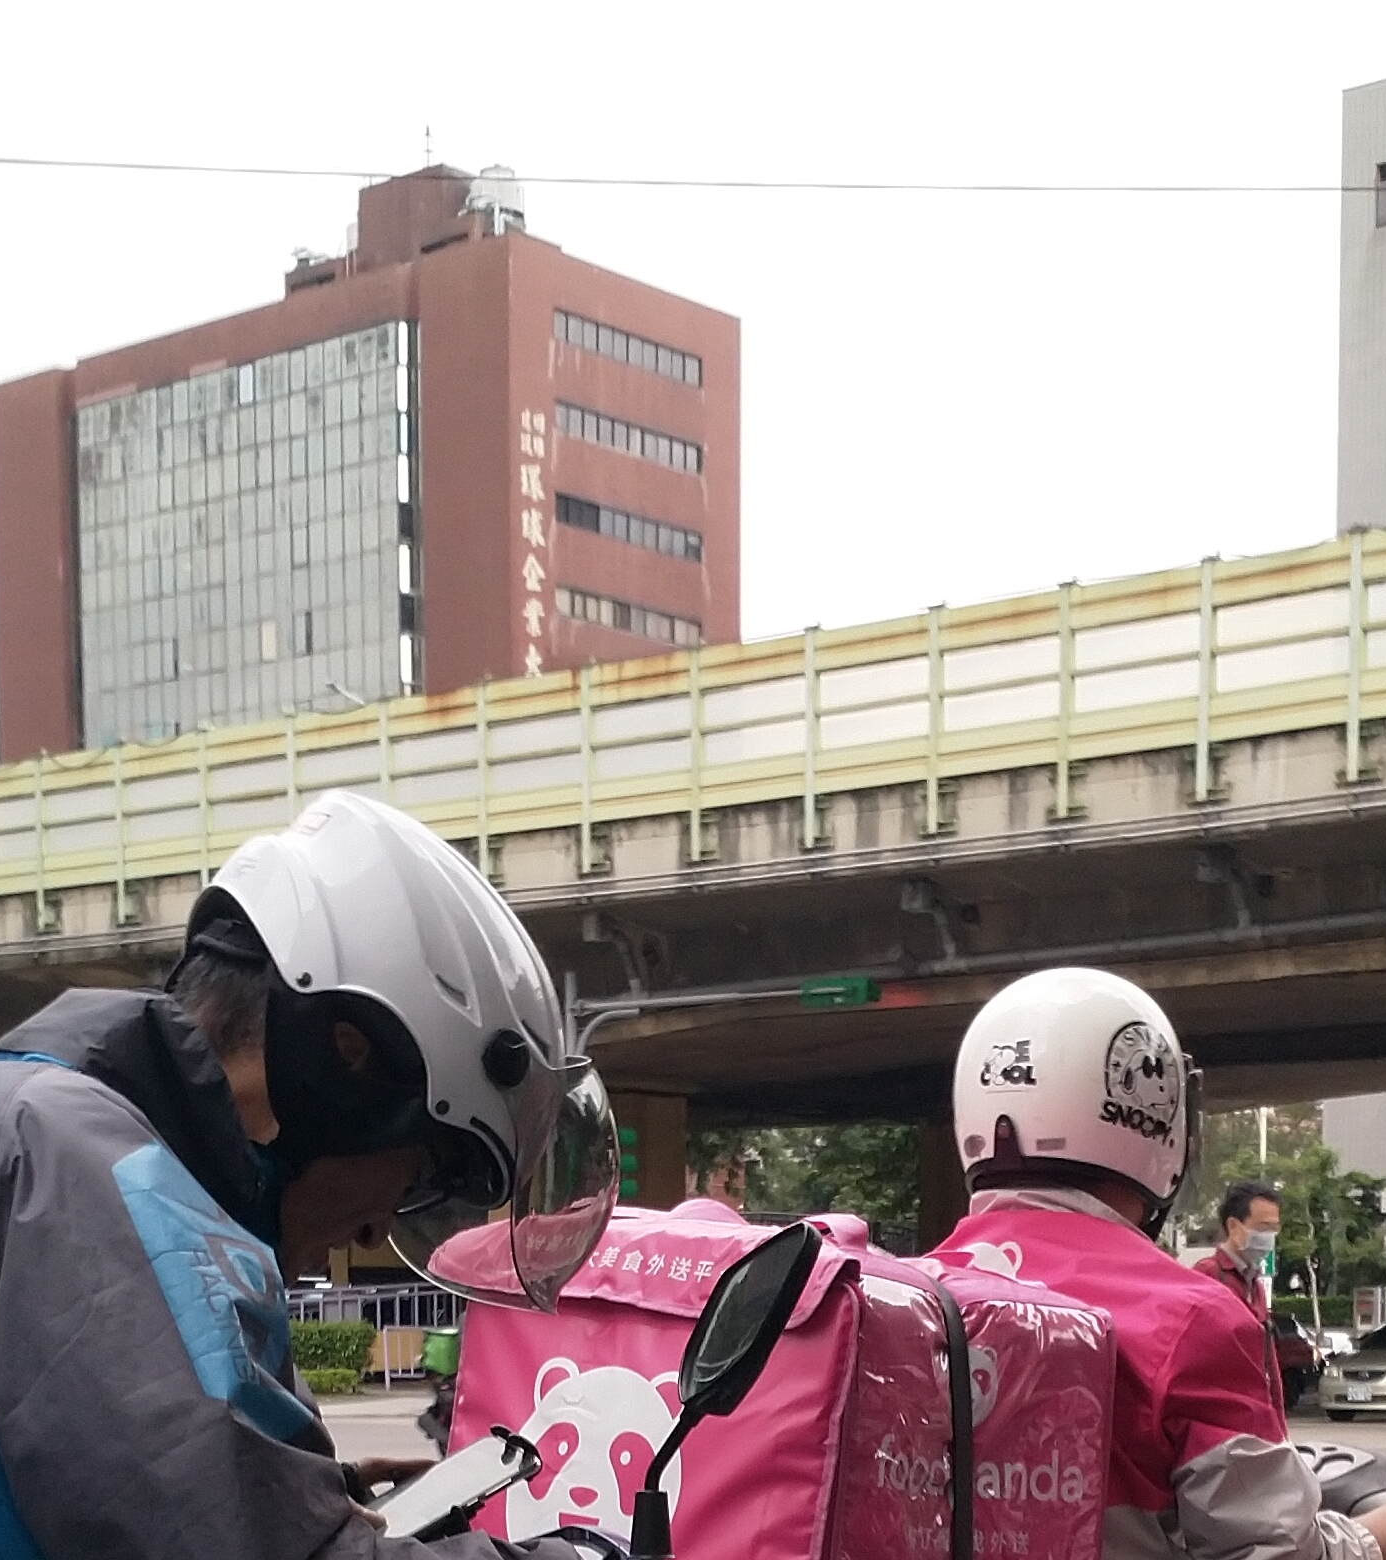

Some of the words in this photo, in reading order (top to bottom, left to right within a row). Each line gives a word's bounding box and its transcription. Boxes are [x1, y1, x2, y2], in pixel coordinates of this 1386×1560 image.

[1099, 1101, 1173, 1147] SNOOPY
[587, 1246, 723, 1284] 美食外送平
[875, 1433, 1085, 1511] foodanda
